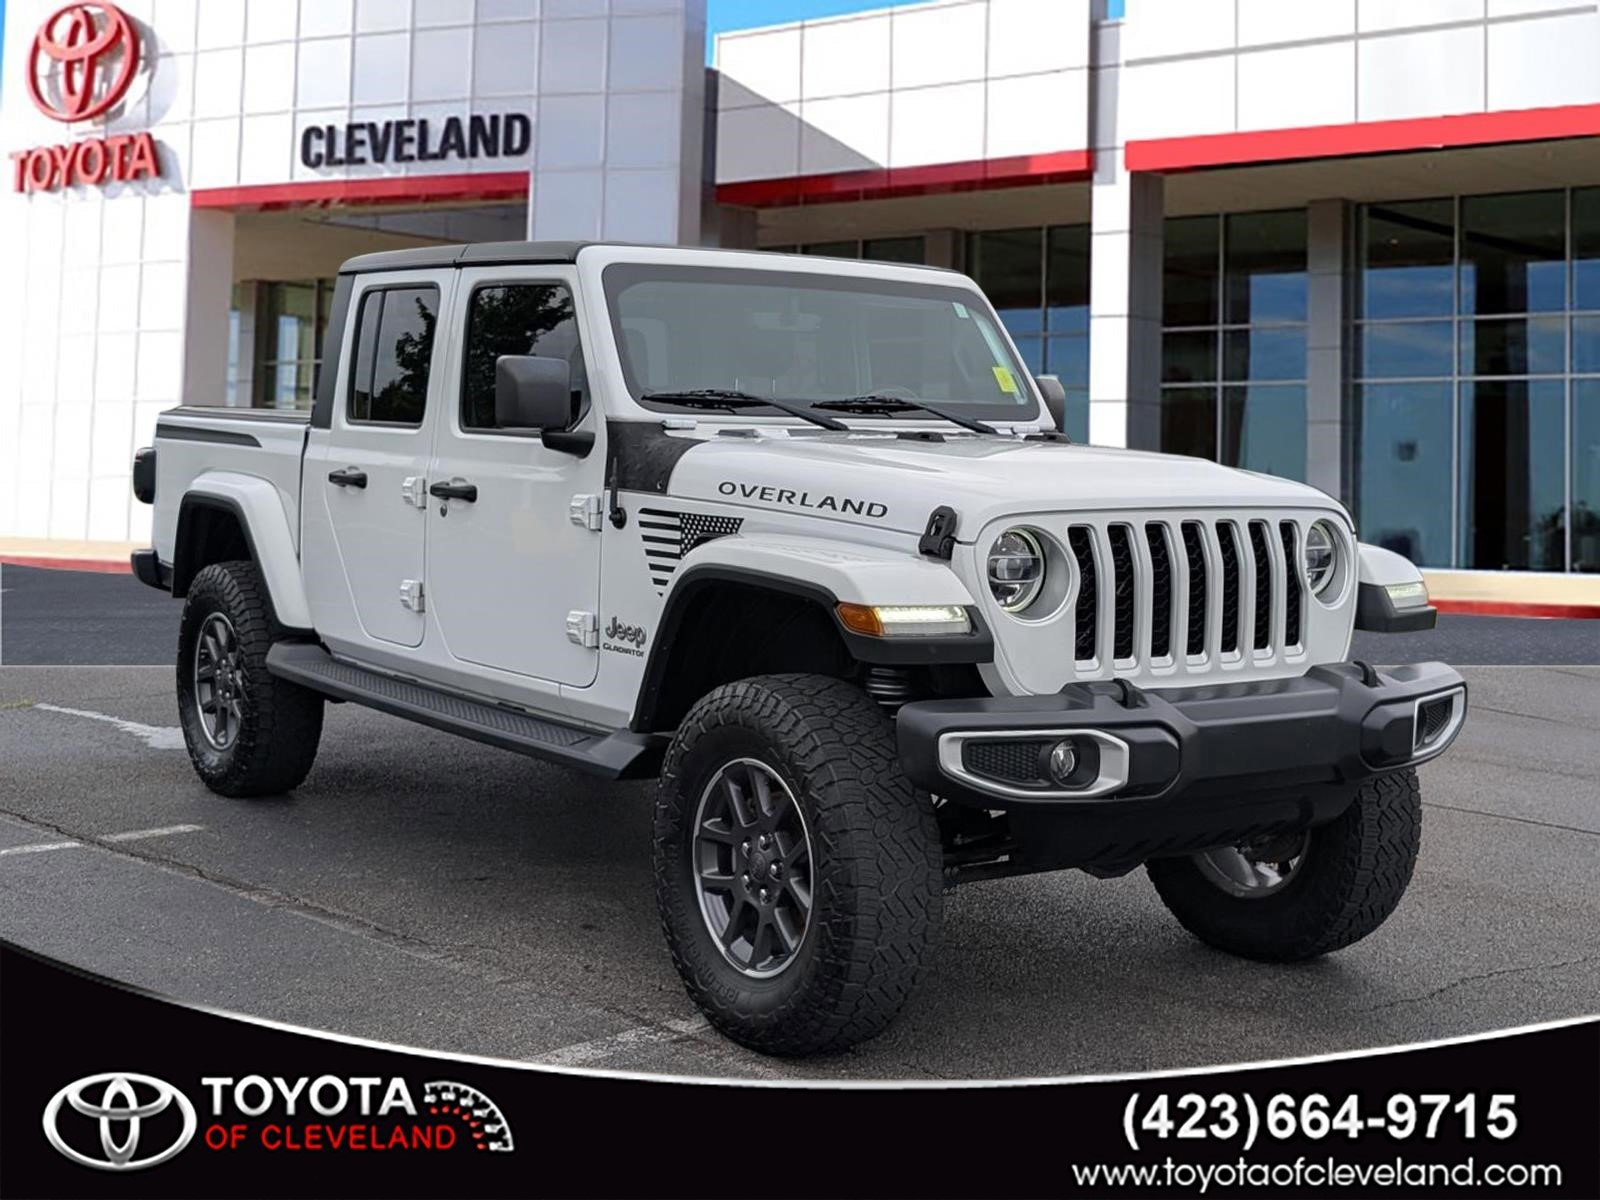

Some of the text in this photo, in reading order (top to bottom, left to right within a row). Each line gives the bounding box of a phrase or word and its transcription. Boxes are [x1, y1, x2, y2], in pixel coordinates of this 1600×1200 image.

[9, 132, 163, 194] TOYOTA
[301, 113, 531, 169] CLEVELAND
[718, 481, 889, 519] OVERLAND
[605, 616, 647, 649] Jeep
